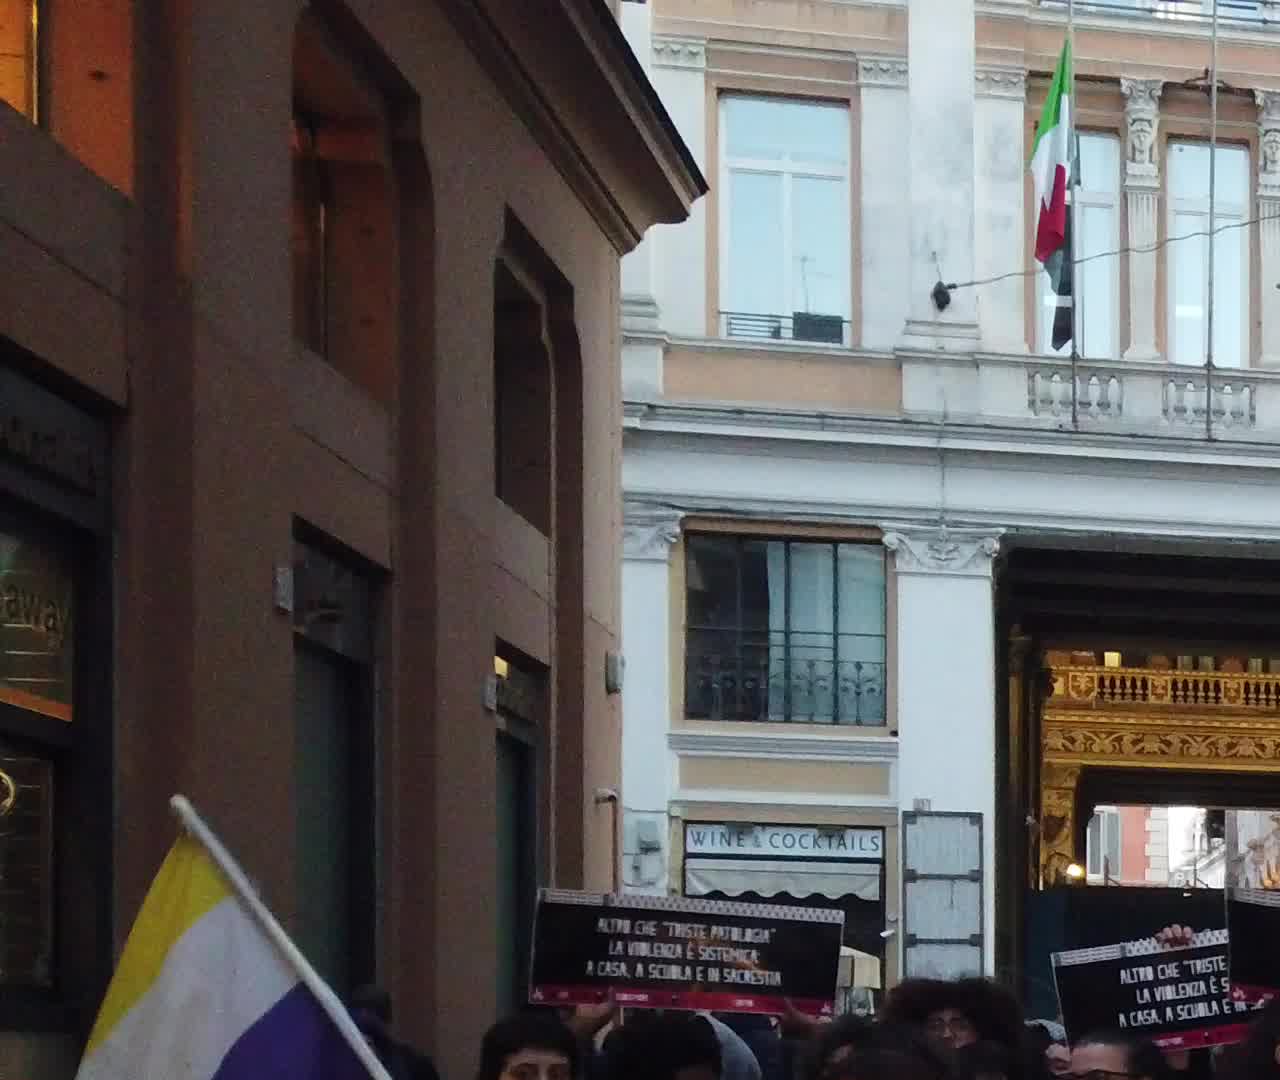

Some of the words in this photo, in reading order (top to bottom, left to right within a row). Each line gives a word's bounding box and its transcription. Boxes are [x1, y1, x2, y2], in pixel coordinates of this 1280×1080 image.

[690, 830, 745, 849] WINE
[768, 831, 881, 852] COCKTAILS
[635, 962, 644, 978] A
[1119, 965, 1155, 985] ALTRO
[1157, 962, 1181, 979] CHE
[1135, 988, 1152, 1004] LA
[1154, 980, 1208, 1002] VIOLENZA
[1118, 1013, 1128, 1029] A
[1165, 1007, 1175, 1022] A
[1176, 1001, 1220, 1021] SCUOLA
[1223, 998, 1232, 1014] E
